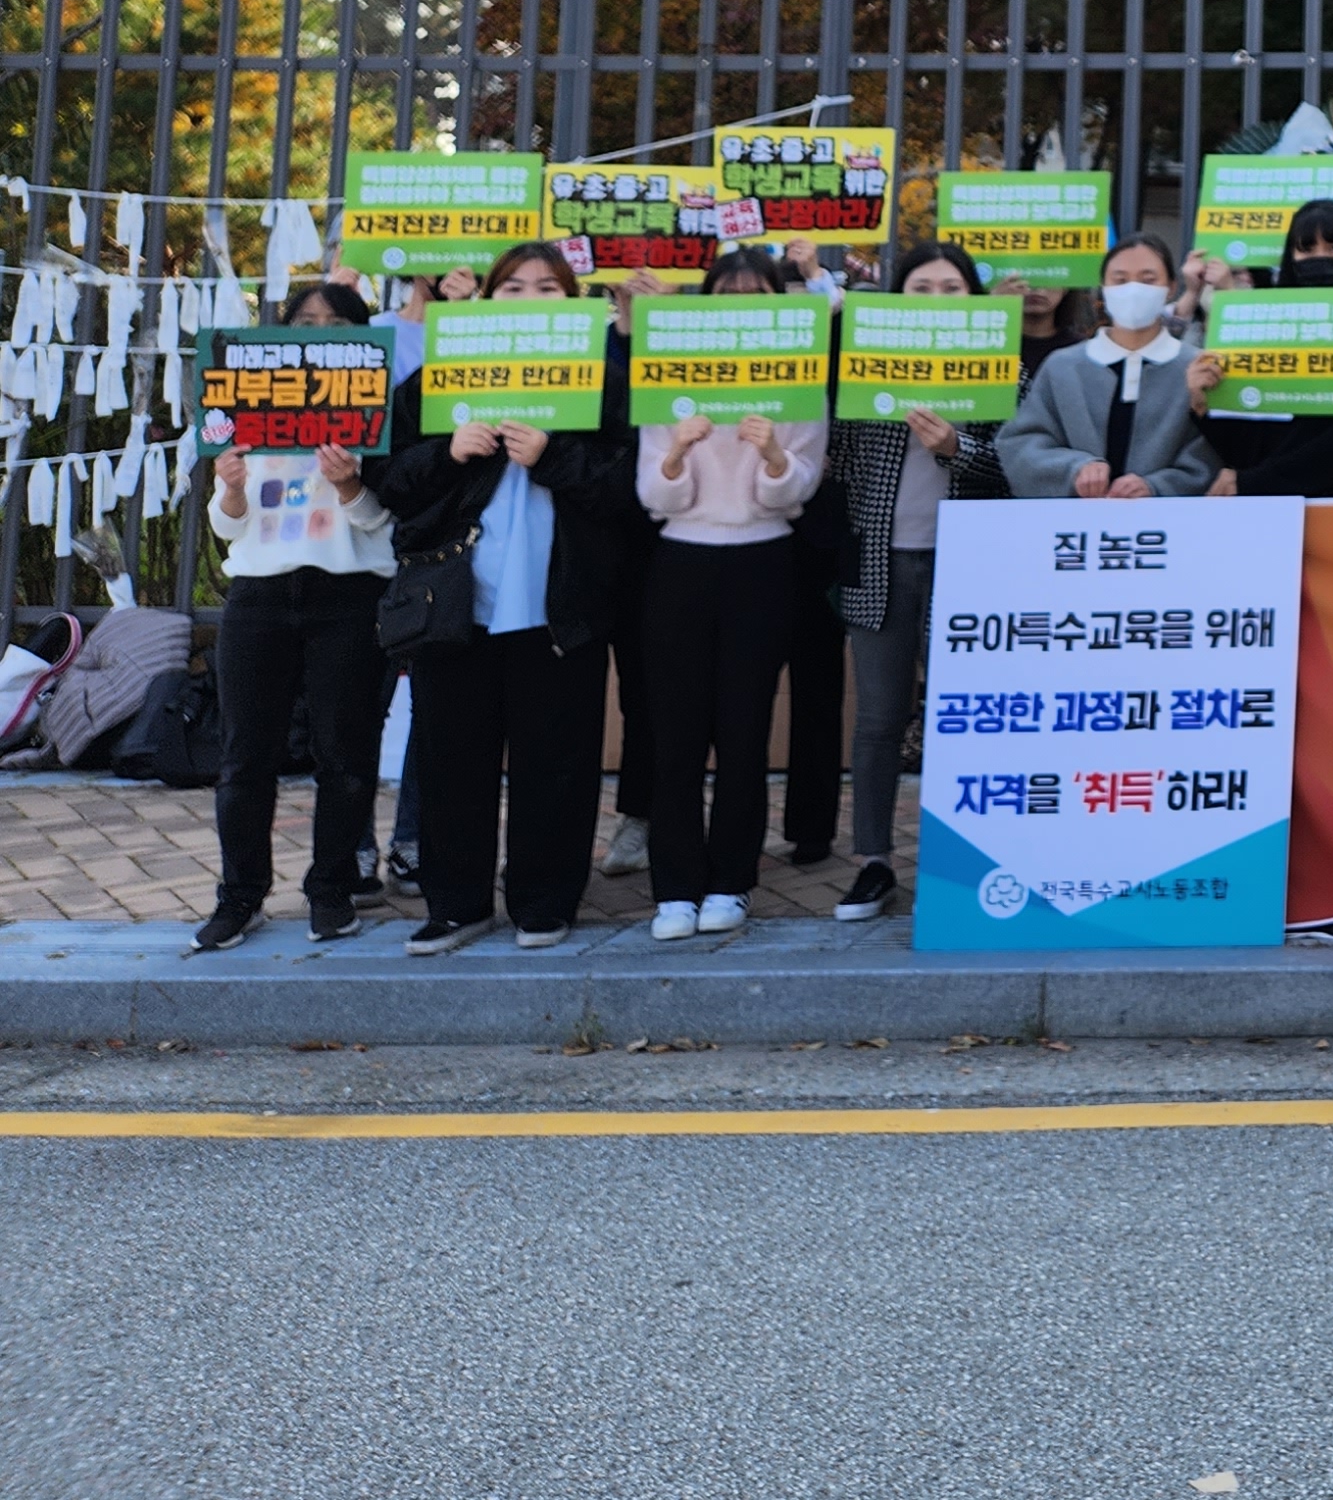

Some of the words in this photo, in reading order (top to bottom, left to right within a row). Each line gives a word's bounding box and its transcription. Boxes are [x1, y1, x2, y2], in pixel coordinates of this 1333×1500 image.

[724, 163, 842, 197] 학생교육
[844, 169, 887, 196] 위한
[554, 201, 675, 234] 학생교육
[765, 198, 882, 229] 보장하라!
[595, 236, 717, 270] 보장하라!
[428, 365, 512, 388] 자격전환
[641, 360, 739, 384] 자격전환
[846, 357, 934, 380] 자격전환
[201, 369, 307, 408] 교부금
[311, 368, 387, 406] 개편
[234, 411, 385, 446] 중단하라!
[1053, 530, 1087, 571] 질
[1098, 529, 1168, 571] 높은
[946, 609, 1194, 653] 유아특수교육을
[1206, 608, 1276, 649] 위해
[936, 692, 1044, 734] 공정한
[1052, 690, 1160, 732] 과정과
[1170, 687, 1276, 730] 절차로
[954, 773, 1061, 815] 자격을
[1074, 769, 1249, 813] '취득'하라!
[1041, 878, 1229, 903] 전국특수교사노동조합
